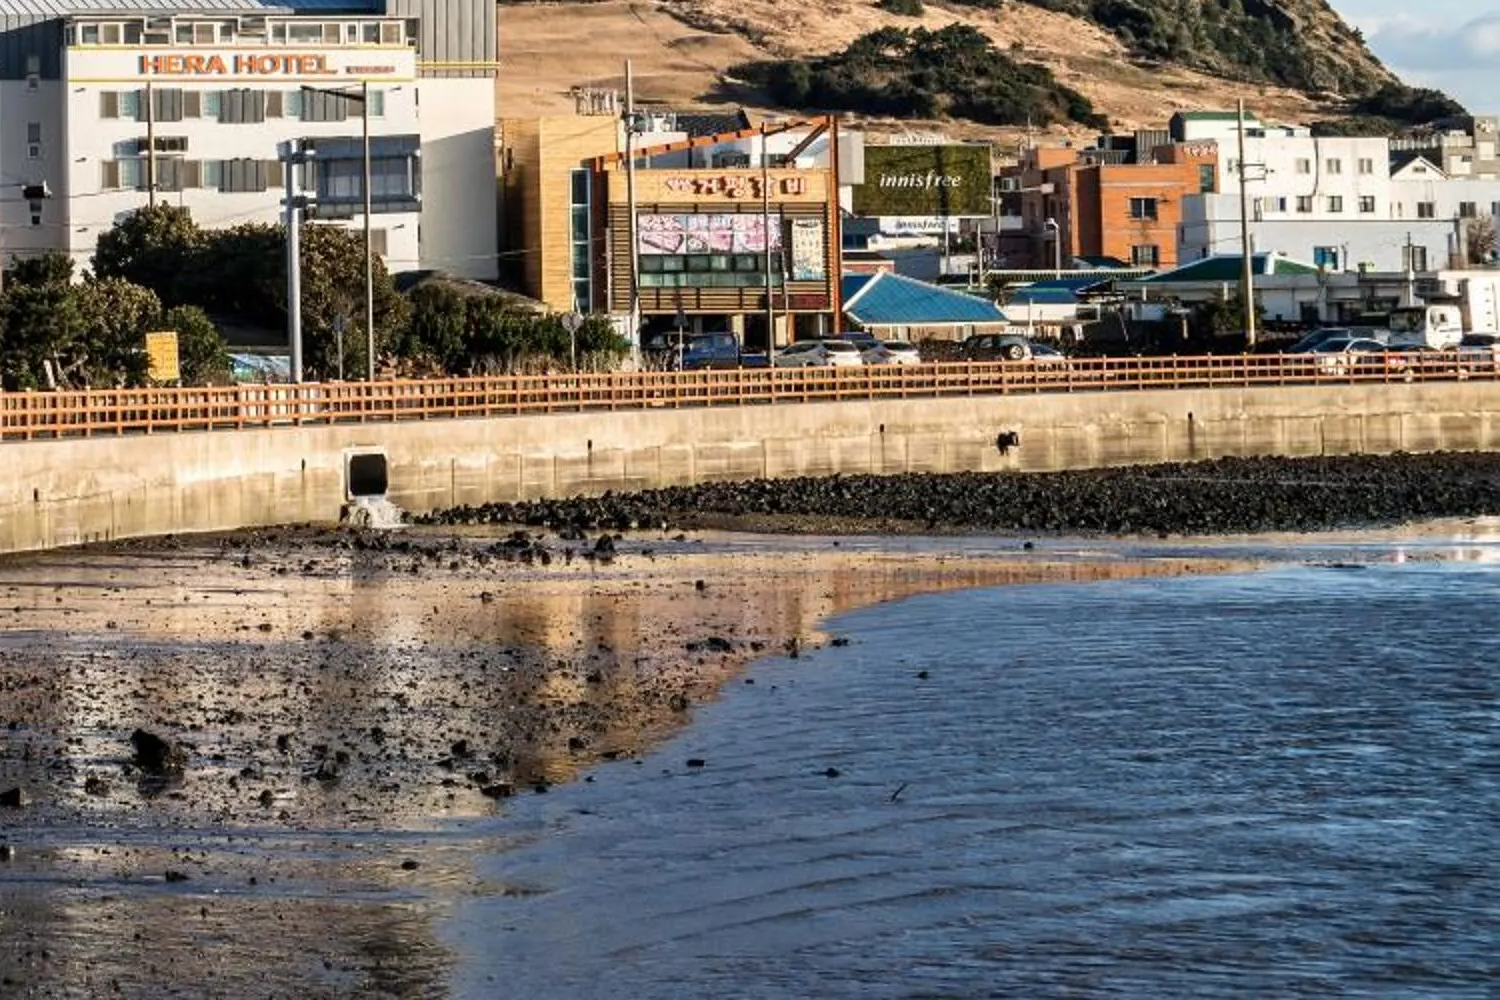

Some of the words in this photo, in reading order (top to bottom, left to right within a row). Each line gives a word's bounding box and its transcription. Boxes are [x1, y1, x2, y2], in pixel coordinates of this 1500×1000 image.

[139, 54, 228, 74] HERA
[233, 54, 338, 74] HOTEL
[880, 169, 961, 190] innisfree
